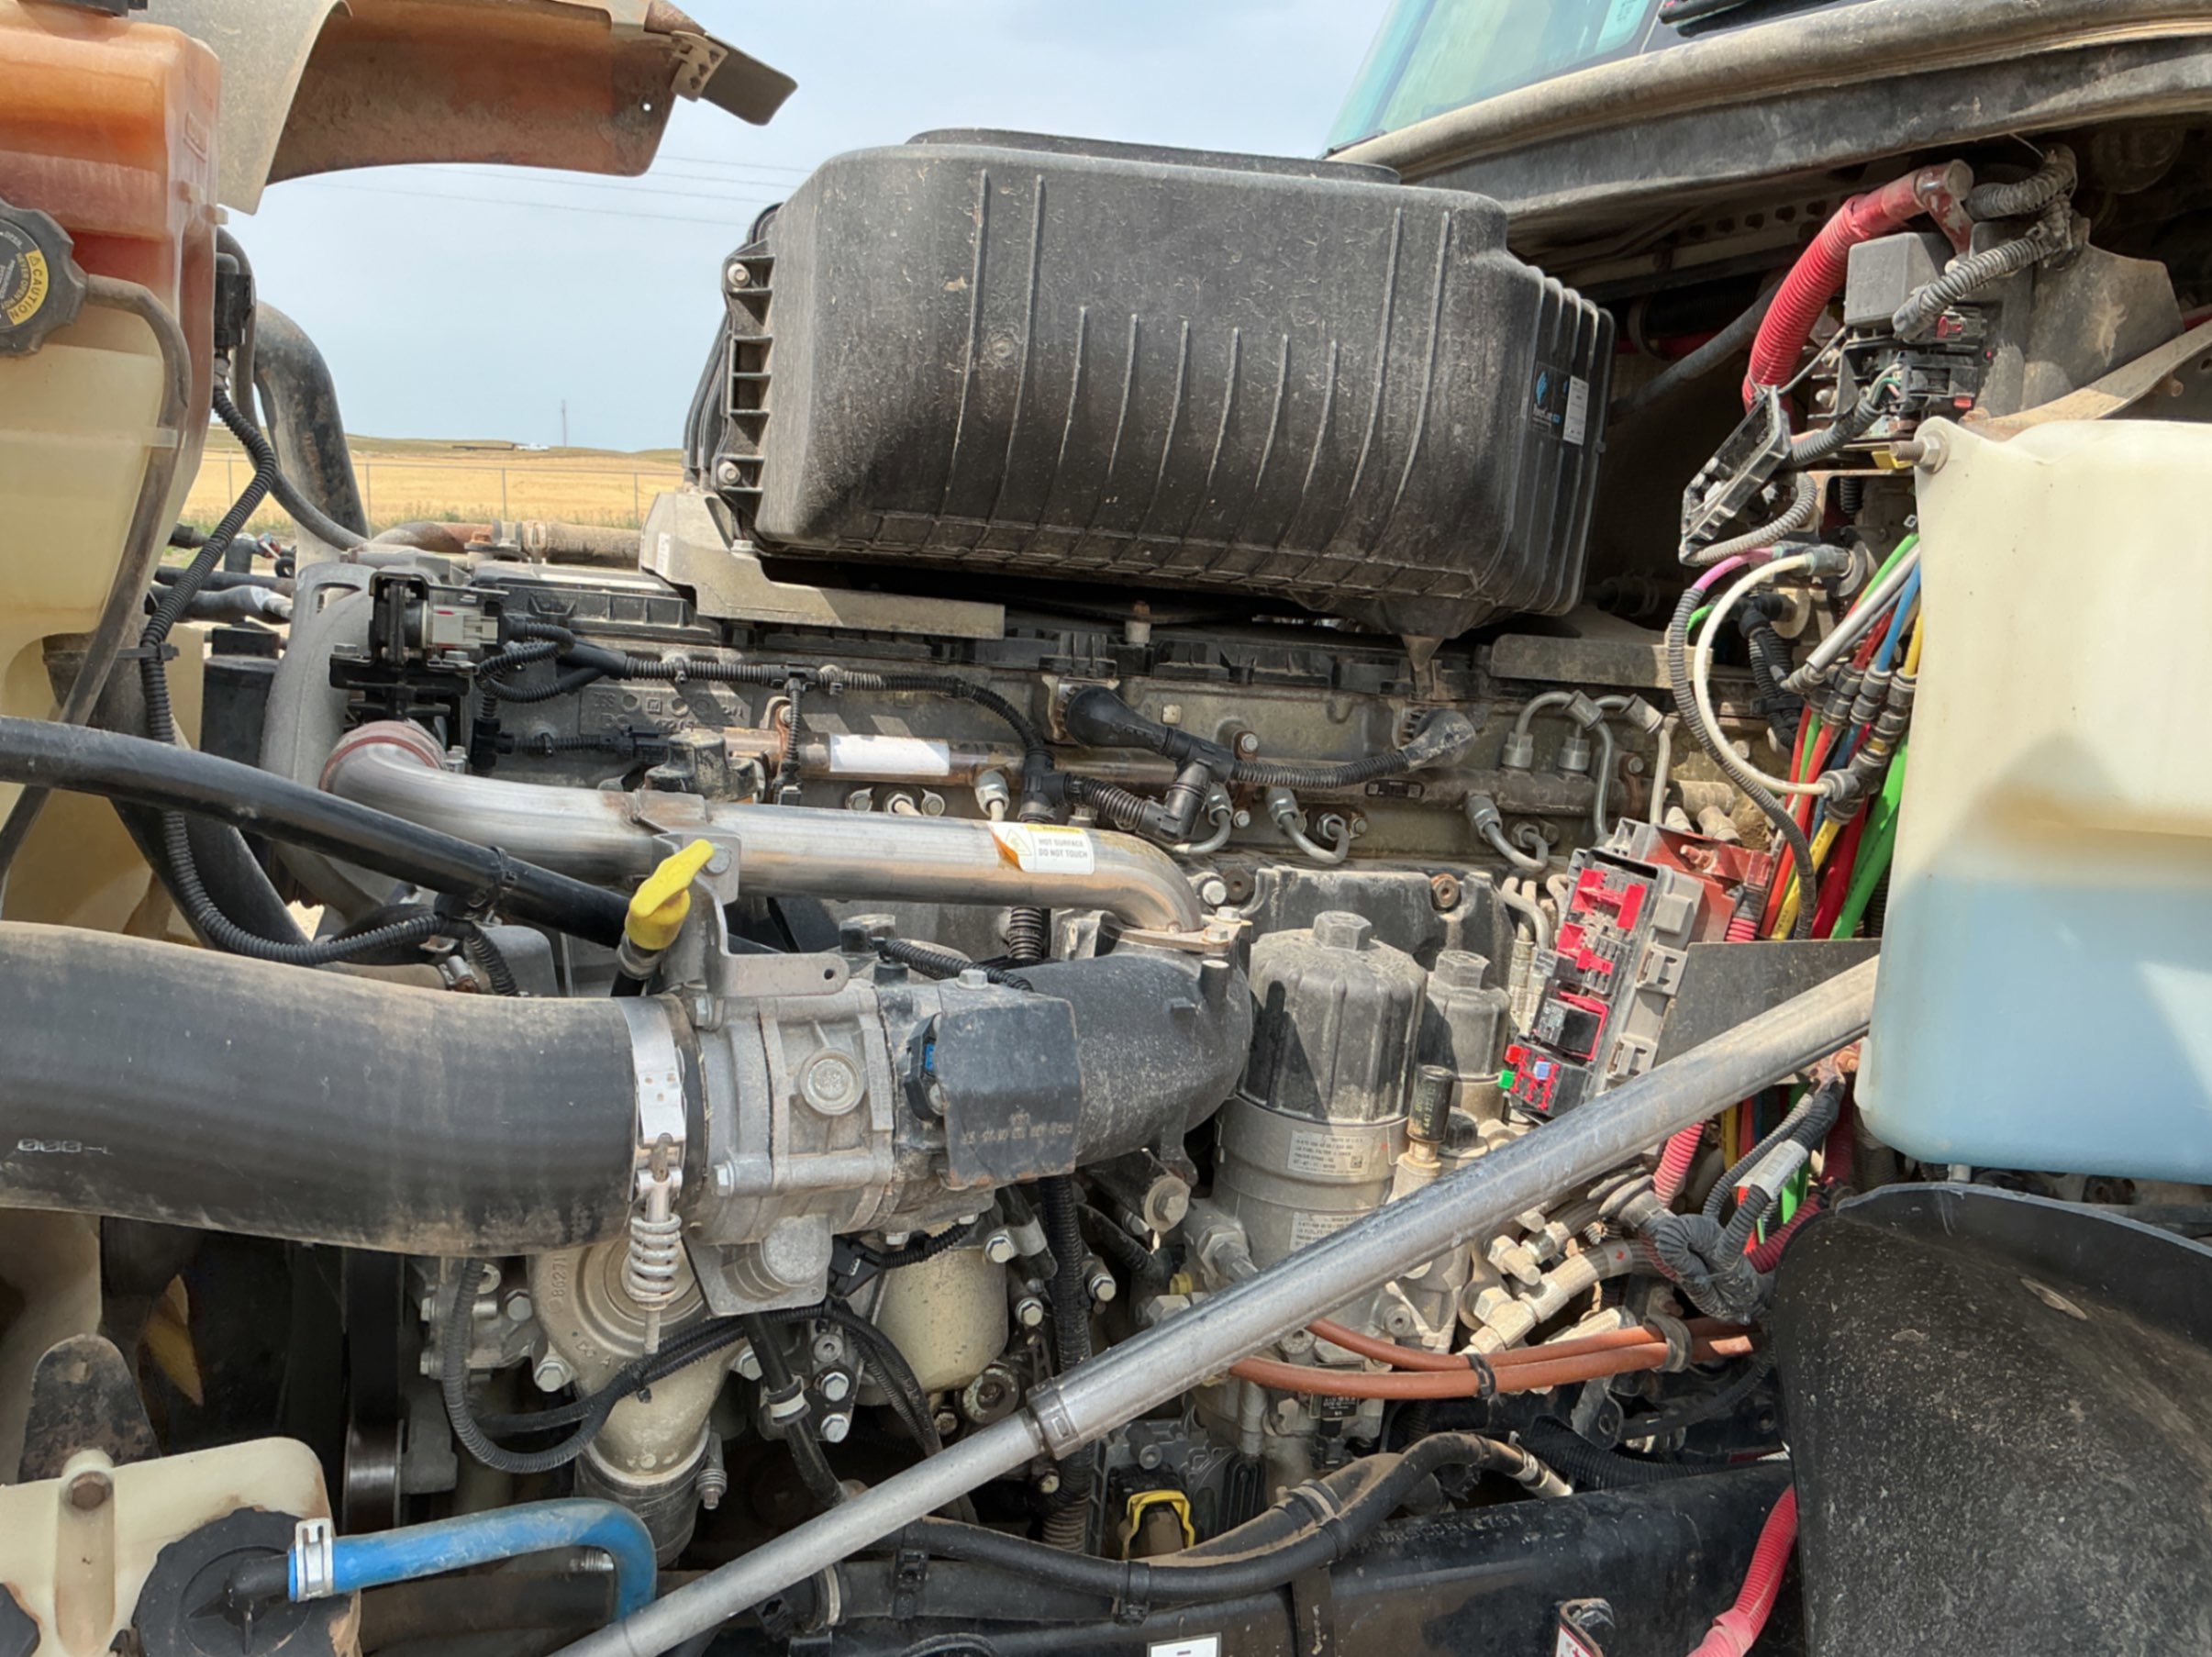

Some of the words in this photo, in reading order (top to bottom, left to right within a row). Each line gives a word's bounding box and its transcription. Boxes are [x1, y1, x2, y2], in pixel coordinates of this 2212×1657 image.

[16, 251, 29, 280] NEVER
[10, 269, 43, 319] CAUTION
[14, 281, 28, 301] OPEN
[1038, 838, 1052, 847] HOT
[1053, 839, 1084, 848] SURFACE
[1039, 849, 1049, 857] DO
[1050, 850, 1064, 858] NOT
[1065, 850, 1088, 859] TOUCH
